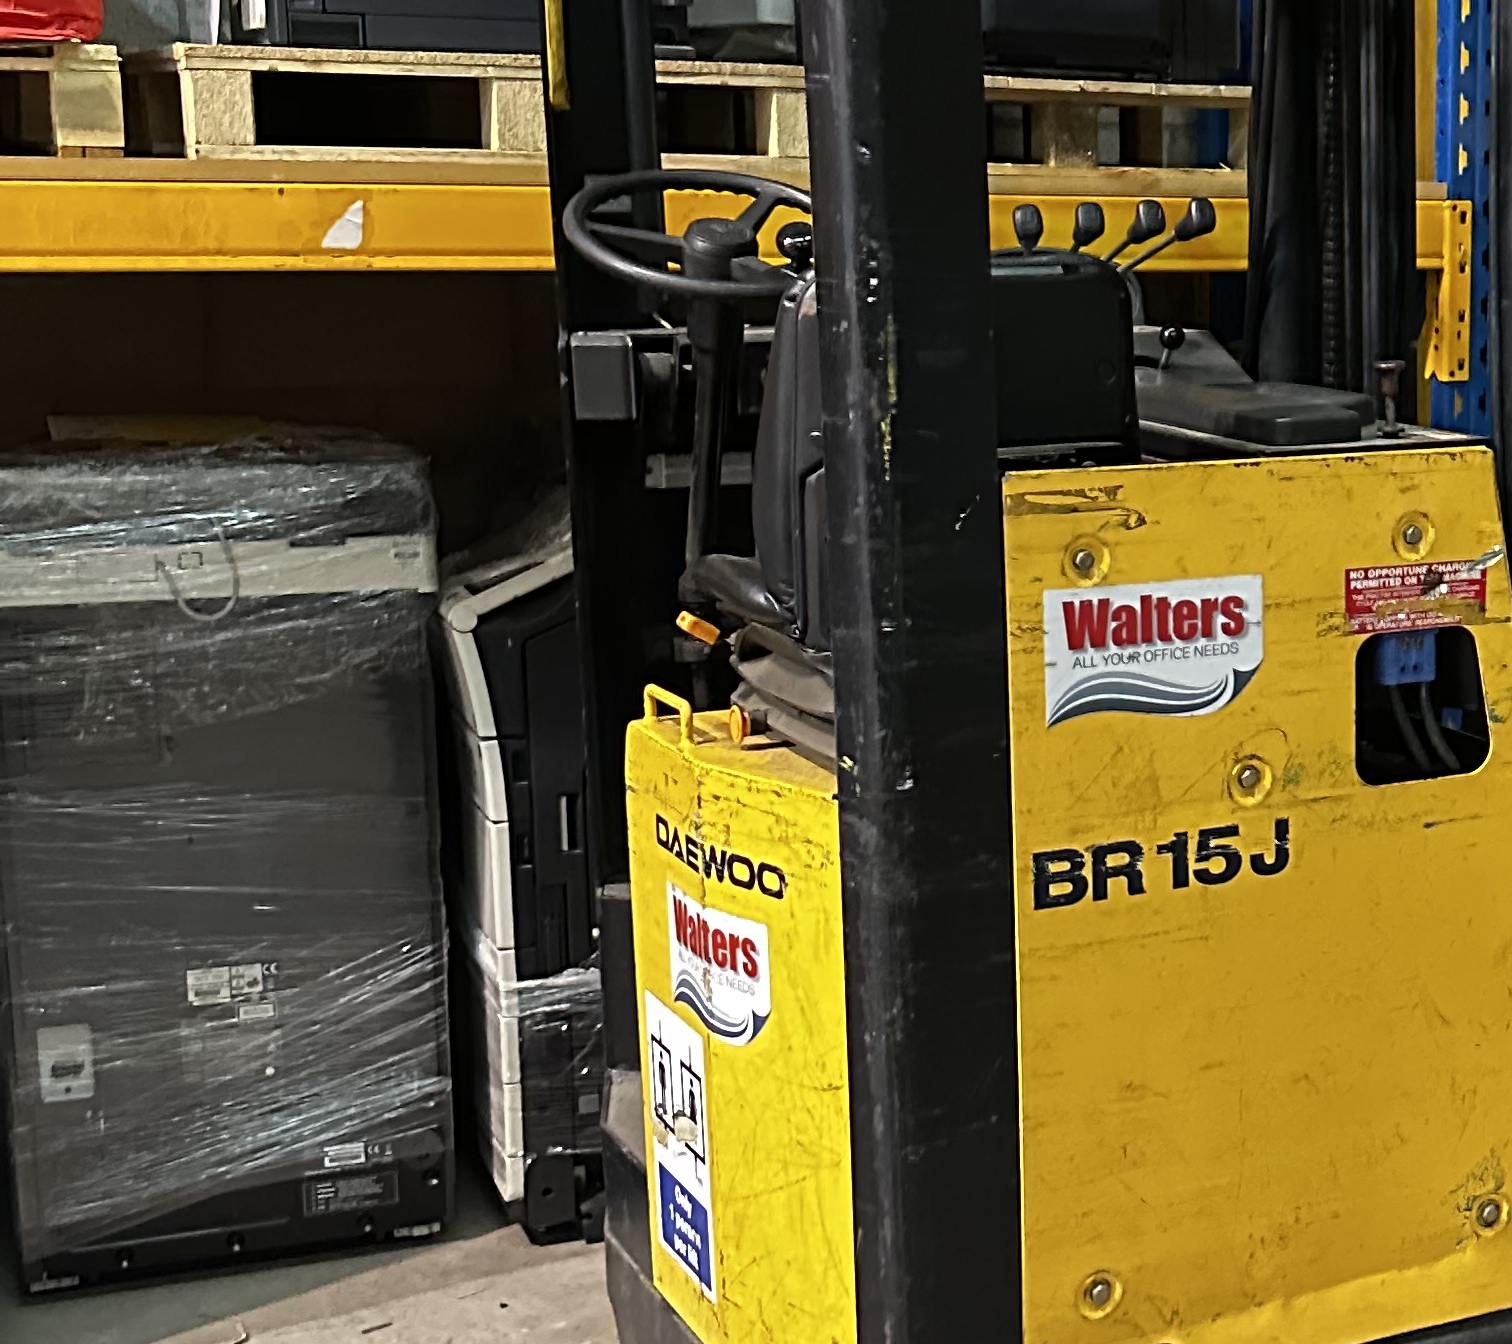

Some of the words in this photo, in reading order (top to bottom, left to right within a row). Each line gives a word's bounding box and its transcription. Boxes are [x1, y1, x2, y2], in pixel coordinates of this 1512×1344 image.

[1350, 570, 1365, 580] NO
[1350, 576, 1402, 589] PERMITTED
[1404, 575, 1418, 585] ON
[1061, 593, 1246, 651] Walters
[1072, 655, 1098, 669] ALL
[1103, 651, 1141, 667] YOUR
[1144, 646, 1190, 663] OFFICE
[1194, 641, 1240, 657] NEEDS
[655, 812, 787, 900] DAEWOO
[672, 893, 760, 979] Walters
